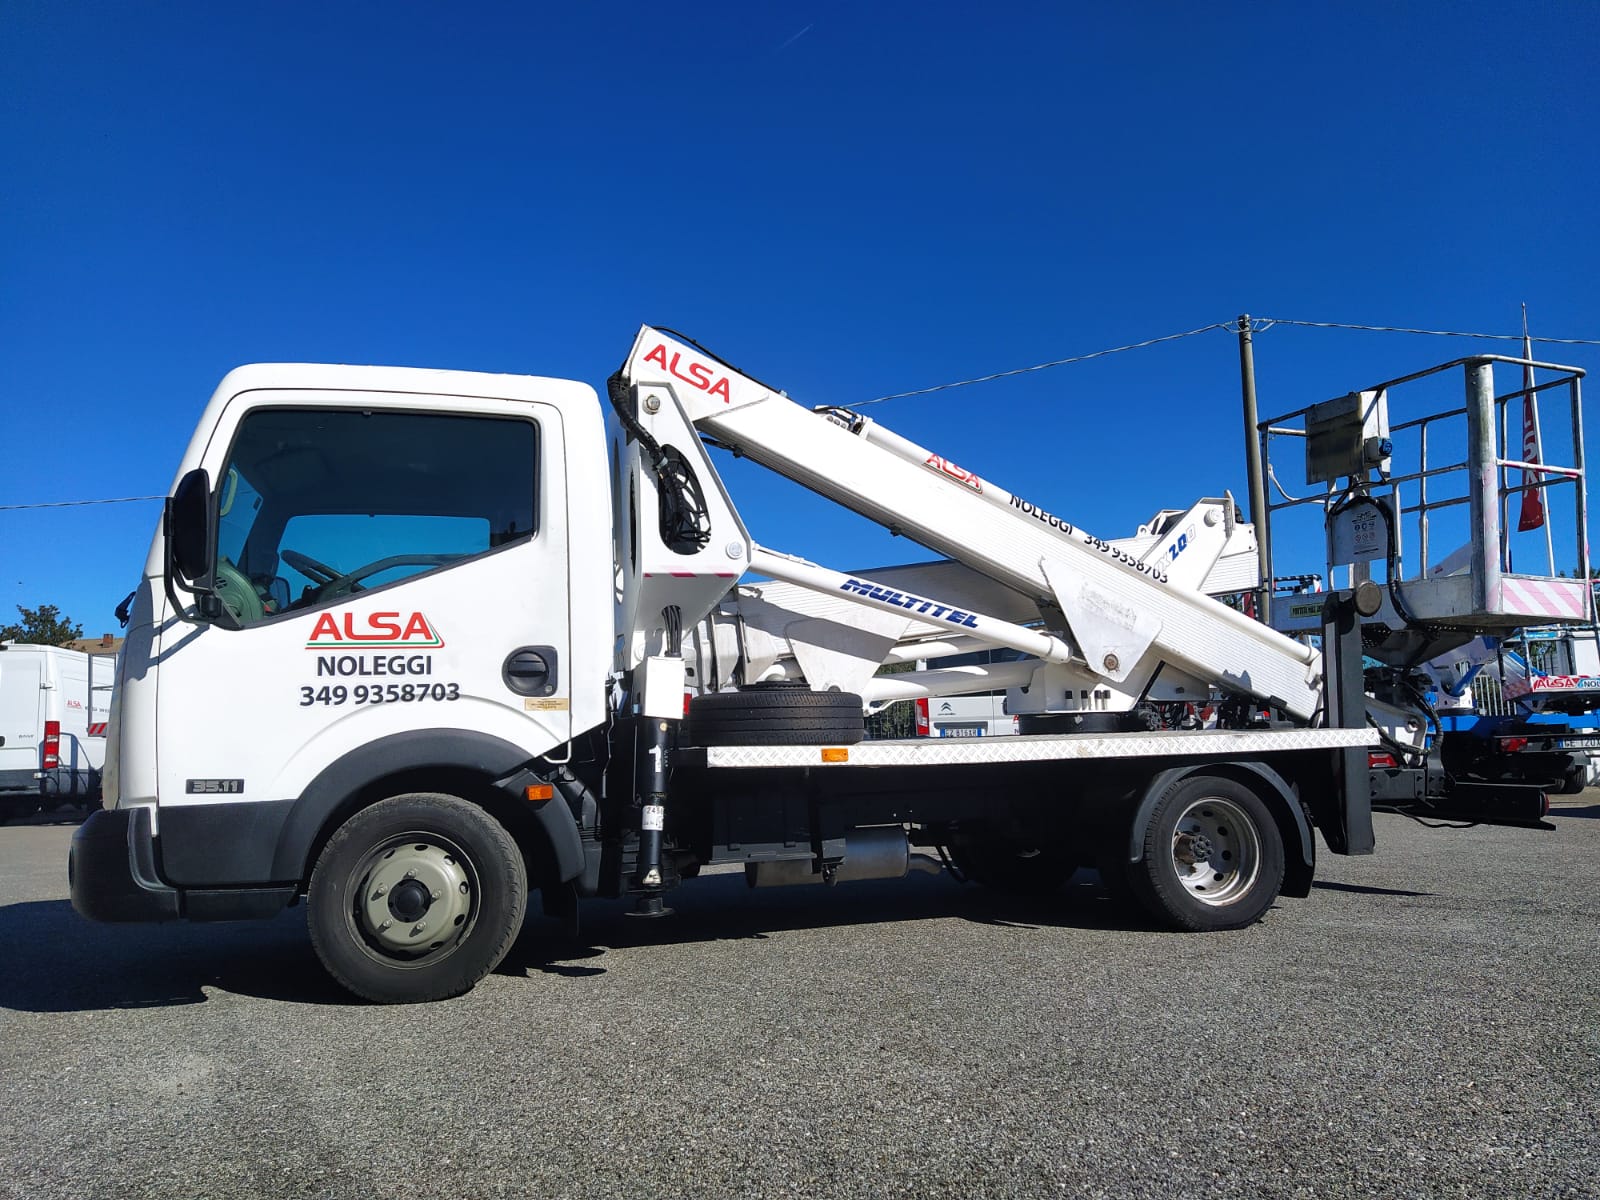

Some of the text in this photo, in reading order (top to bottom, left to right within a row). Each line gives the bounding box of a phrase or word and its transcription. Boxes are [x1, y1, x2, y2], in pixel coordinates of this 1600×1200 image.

[643, 344, 730, 404] ALSA
[926, 453, 1168, 584] ALSA NOLEGGI 349 9358703
[840, 579, 979, 629] MULTITEL
[309, 612, 433, 641] ALSA
[317, 655, 432, 677] NOLEGGI
[300, 683, 460, 707] 349 9358703
[1536, 678, 1576, 688] ALSA
[192, 780, 239, 793] 35.11
